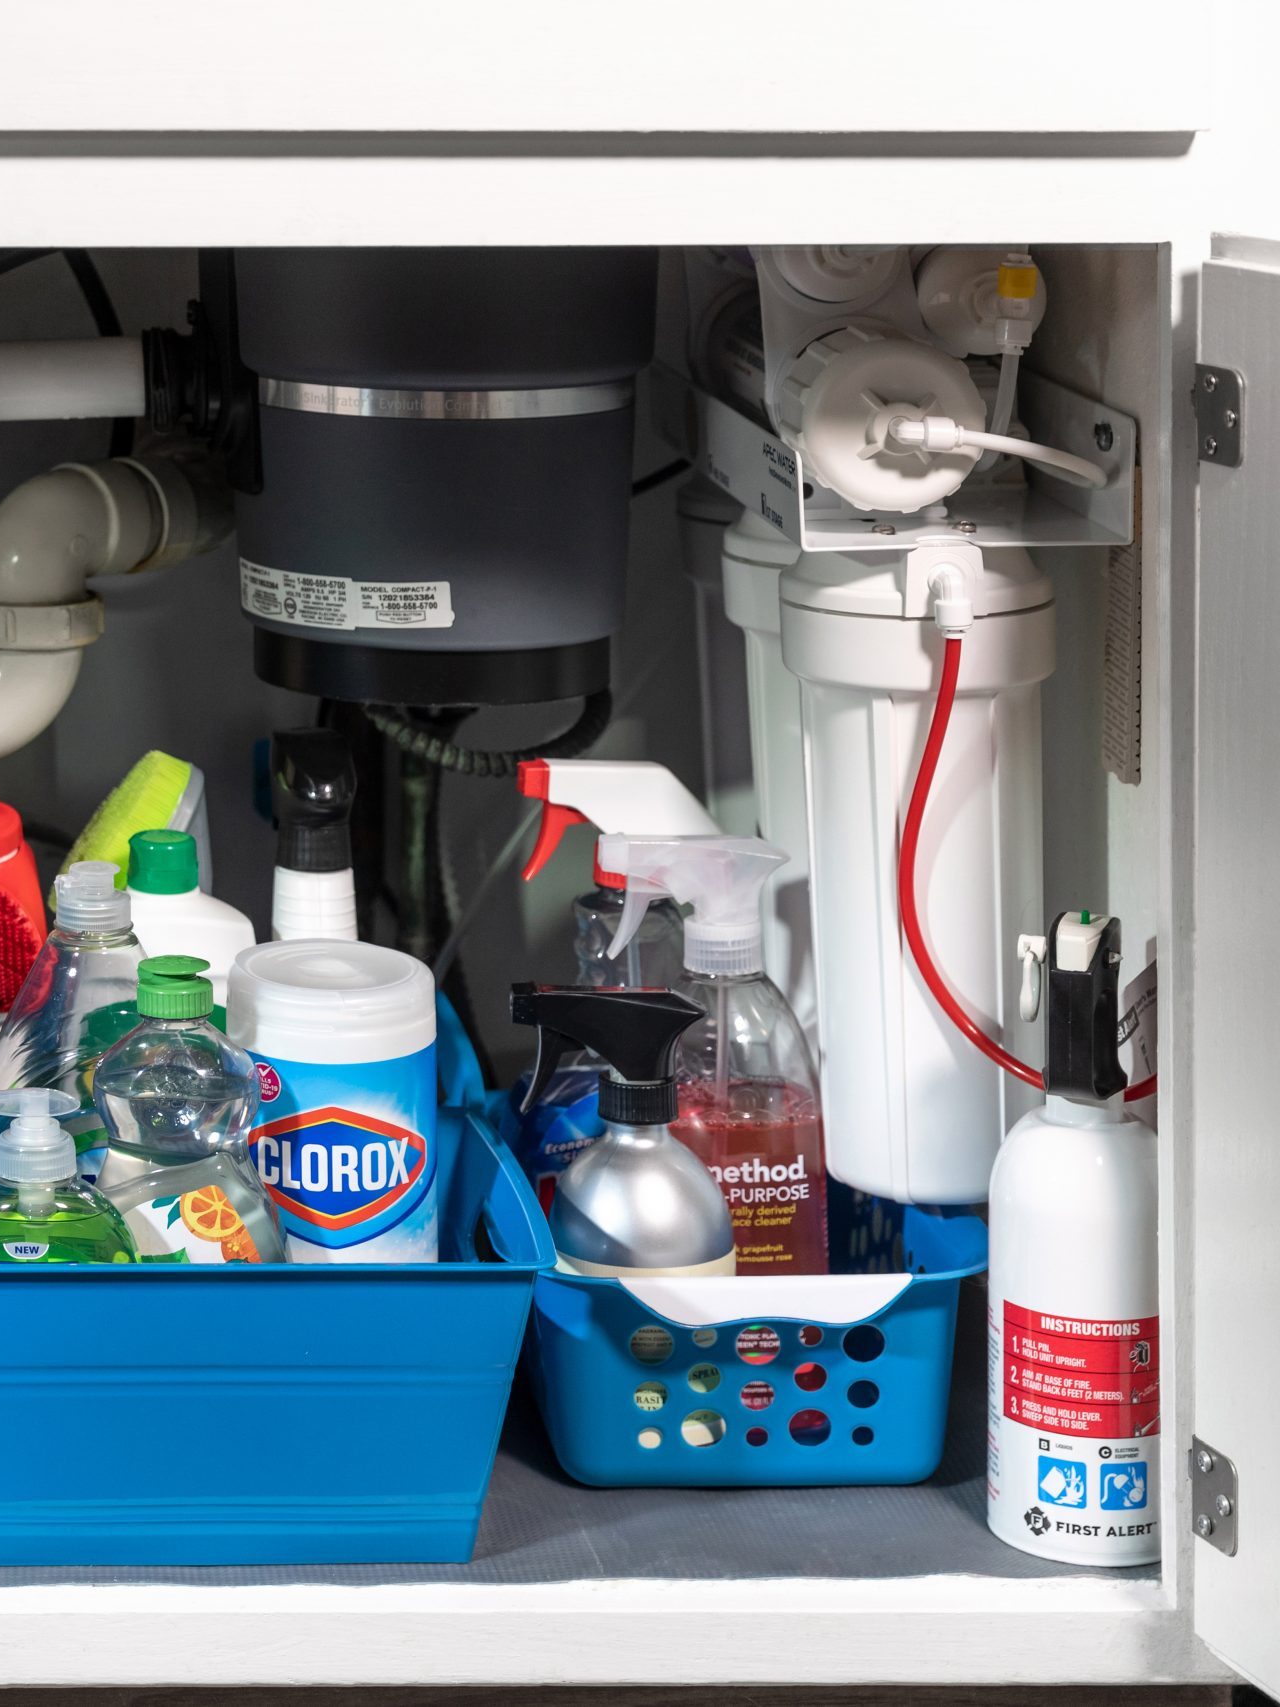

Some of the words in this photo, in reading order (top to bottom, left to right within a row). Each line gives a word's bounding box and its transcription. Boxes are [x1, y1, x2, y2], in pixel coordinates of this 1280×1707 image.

[544, 1137, 598, 1155] Econom
[257, 1136, 410, 1193] CLOROX
[756, 1203, 797, 1216] derived
[754, 1216, 792, 1227] cleaner
[14, 1245, 40, 1255] NEW
[1041, 1316, 1140, 1337] INSTRUCTIONS
[1012, 1335, 1020, 1354] 1.
[1022, 1337, 1037, 1351] PULL
[1038, 1342, 1051, 1353] PIN.
[1022, 1347, 1038, 1360] HOLD
[1039, 1351, 1055, 1363] UNIT
[1056, 1355, 1087, 1368] UPRIGHT.
[1011, 1365, 1020, 1385] 2.
[1022, 1368, 1034, 1380] AIM
[1035, 1372, 1044, 1383] AT
[1044, 1374, 1062, 1387] BASE
[1063, 1378, 1073, 1388] OF
[1074, 1380, 1092, 1391] FIRE.
[1022, 1377, 1041, 1392] STAND
[1042, 1383, 1061, 1397] BACK
[1061, 1387, 1067, 1398] 6
[1067, 1388, 1084, 1400] FEET
[1085, 1391, 1093, 1402] (2
[1093, 1391, 1125, 1403] METERS).
[1011, 1396, 1020, 1415] 3.
[1022, 1399, 1042, 1413] PRESS
[1043, 1404, 1057, 1417] AND
[1058, 1408, 1077, 1420] HOLD
[1078, 1411, 1102, 1422] LEVER.
[1022, 1409, 1043, 1422] SWEEP
[1043, 1414, 1059, 1427] SIDE
[1061, 1418, 1070, 1428] TO
[1070, 1419, 1090, 1430] SIDE.
[1055, 1521, 1101, 1537] FIRST
[1105, 1522, 1153, 1538] ALERT
